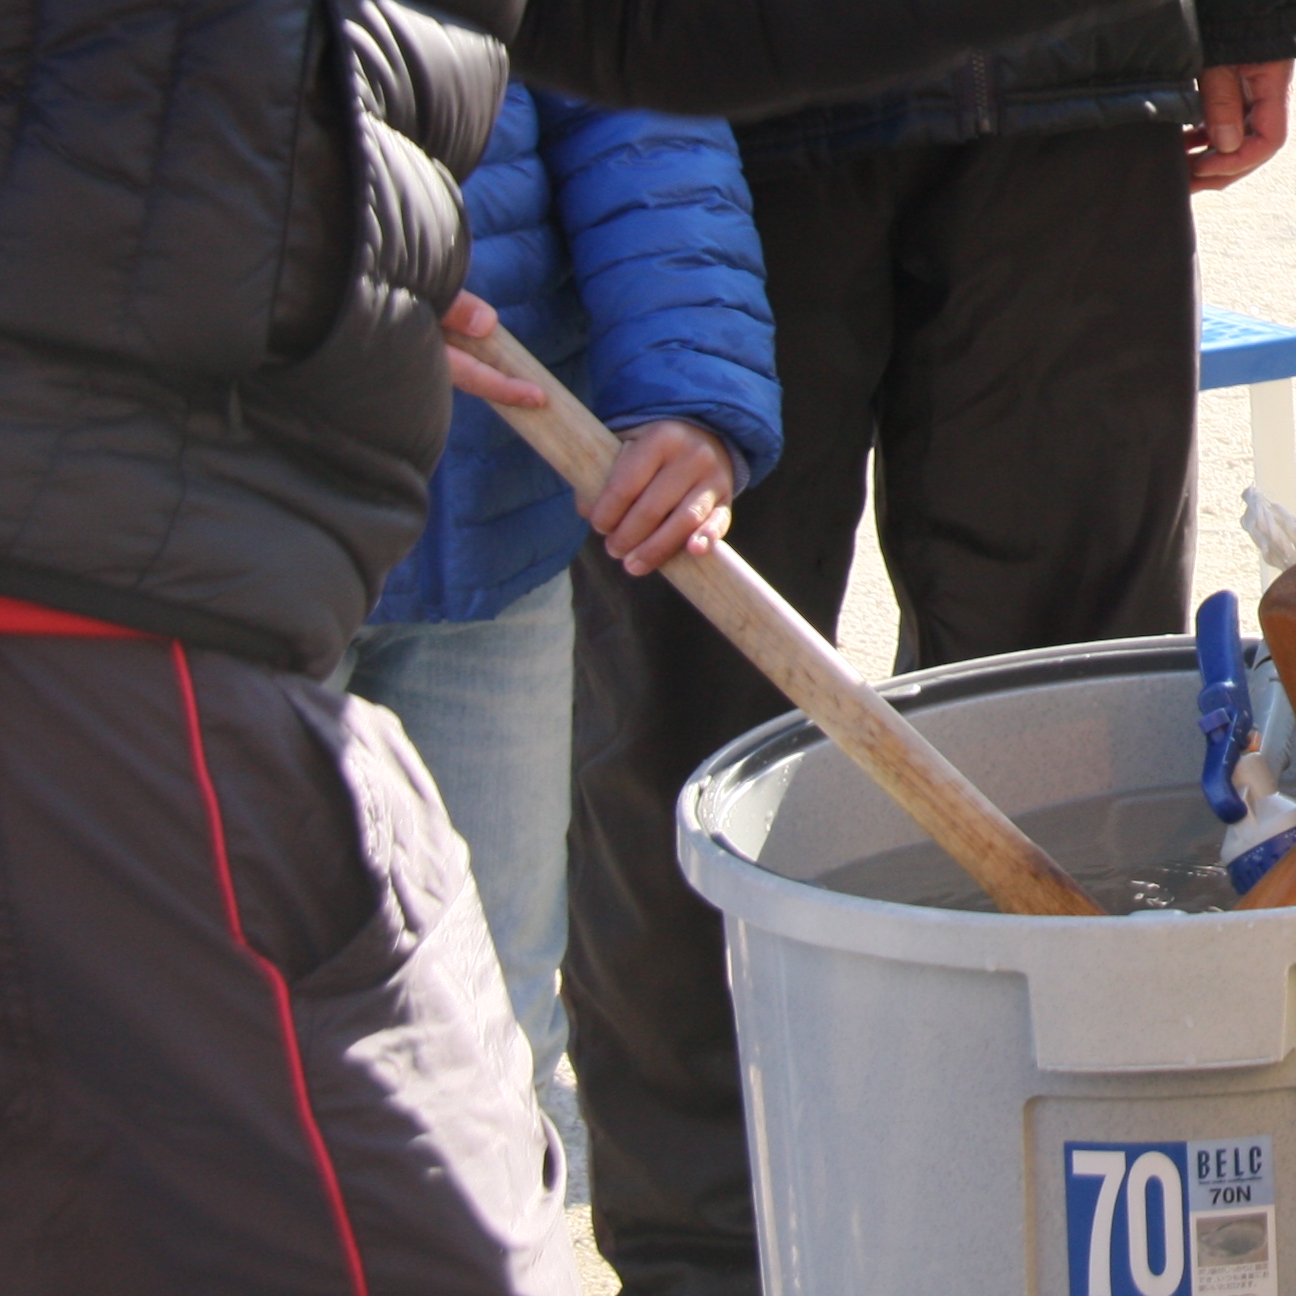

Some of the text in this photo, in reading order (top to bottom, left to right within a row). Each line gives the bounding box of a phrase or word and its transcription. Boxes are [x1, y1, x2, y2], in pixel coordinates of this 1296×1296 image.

[1197, 1146, 1262, 1180] BELC
[1210, 1185, 1251, 1205] 70N
[1072, 1150, 1184, 1296] 70
